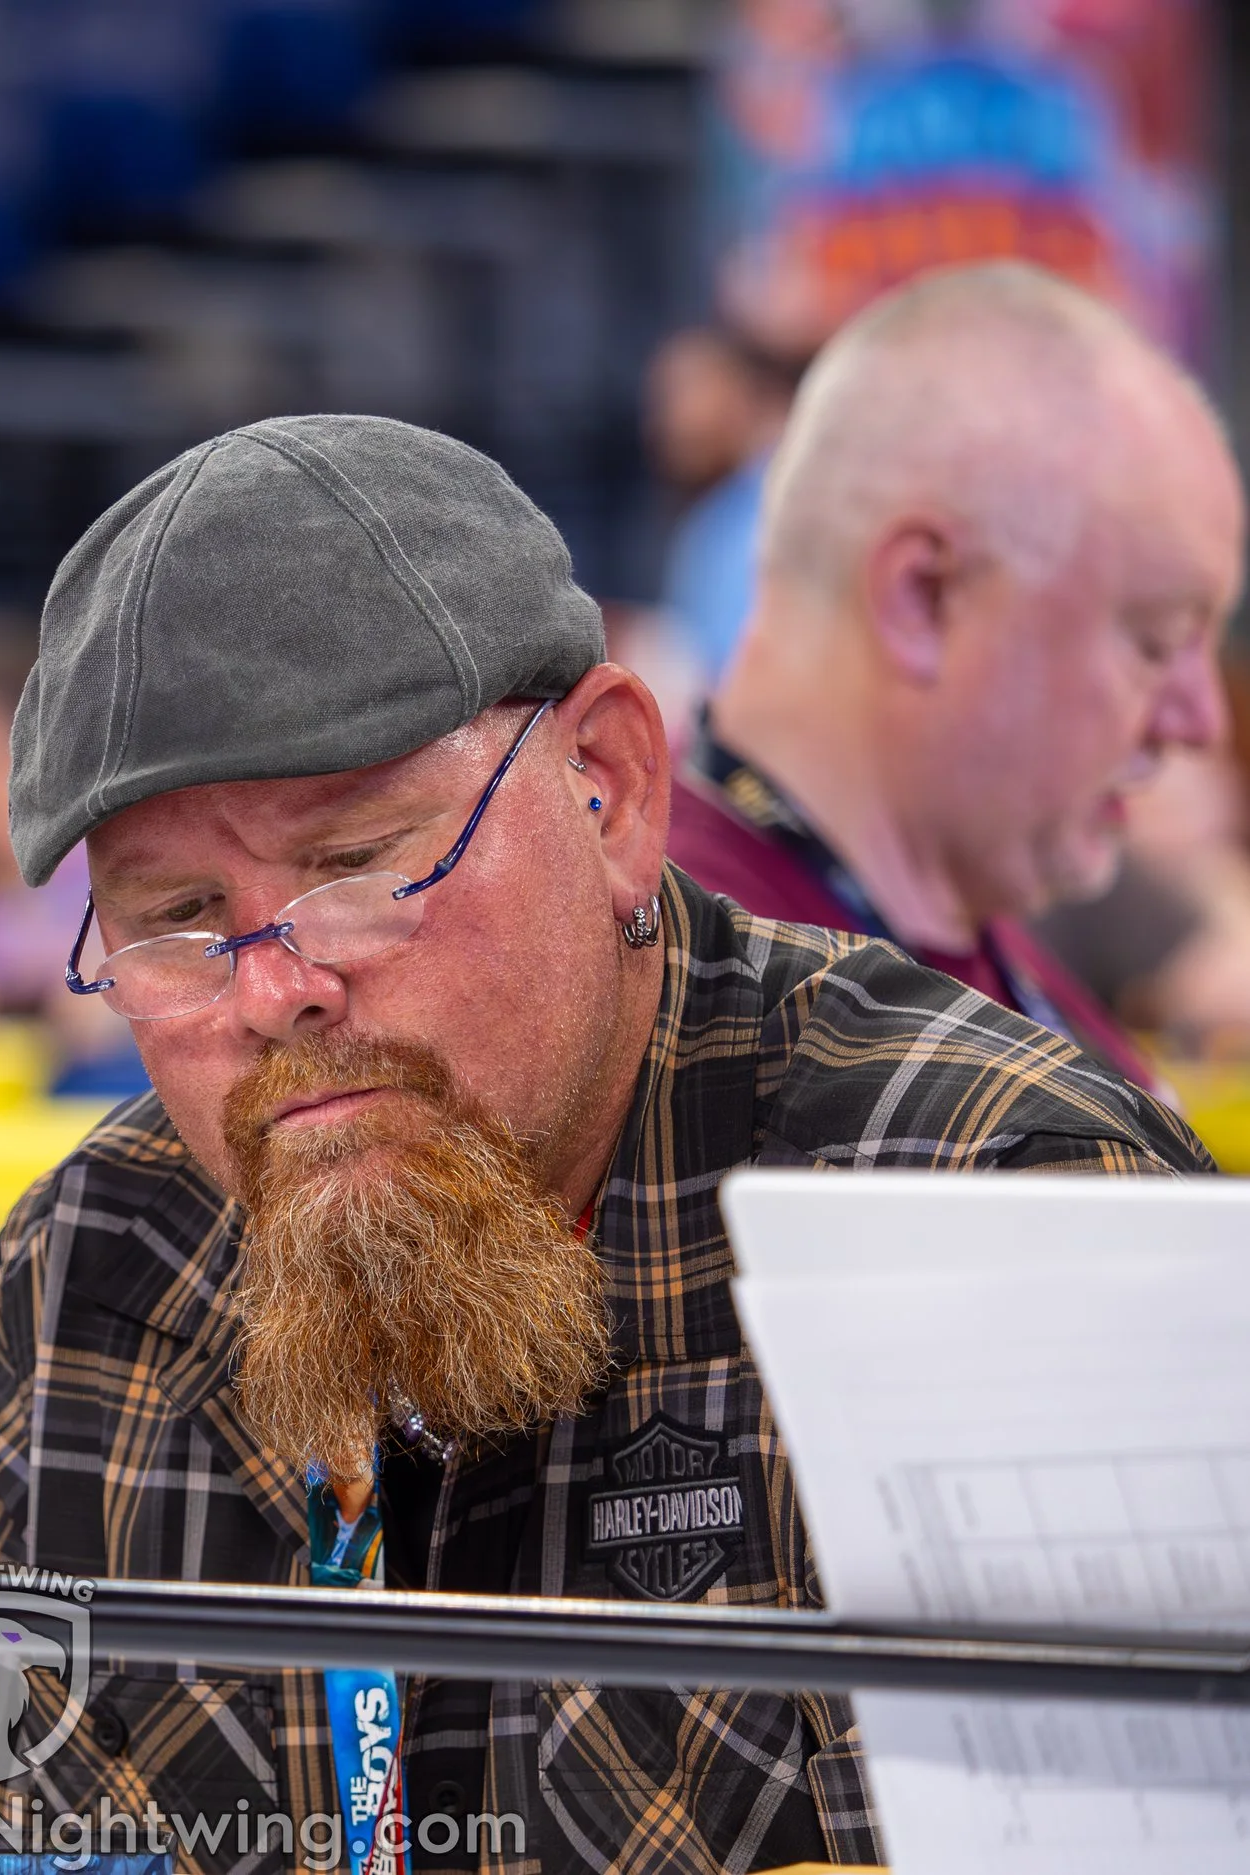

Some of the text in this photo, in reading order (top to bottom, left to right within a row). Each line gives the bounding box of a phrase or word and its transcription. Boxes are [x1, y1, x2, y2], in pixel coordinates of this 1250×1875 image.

[621, 1434, 705, 1482] MOTOR
[594, 1486, 743, 1541] HARLEY-DAVIDSON
[627, 1541, 708, 1596] CYCLES
[354, 1687, 394, 1816] BOYS
[350, 1776, 368, 1826] THE
